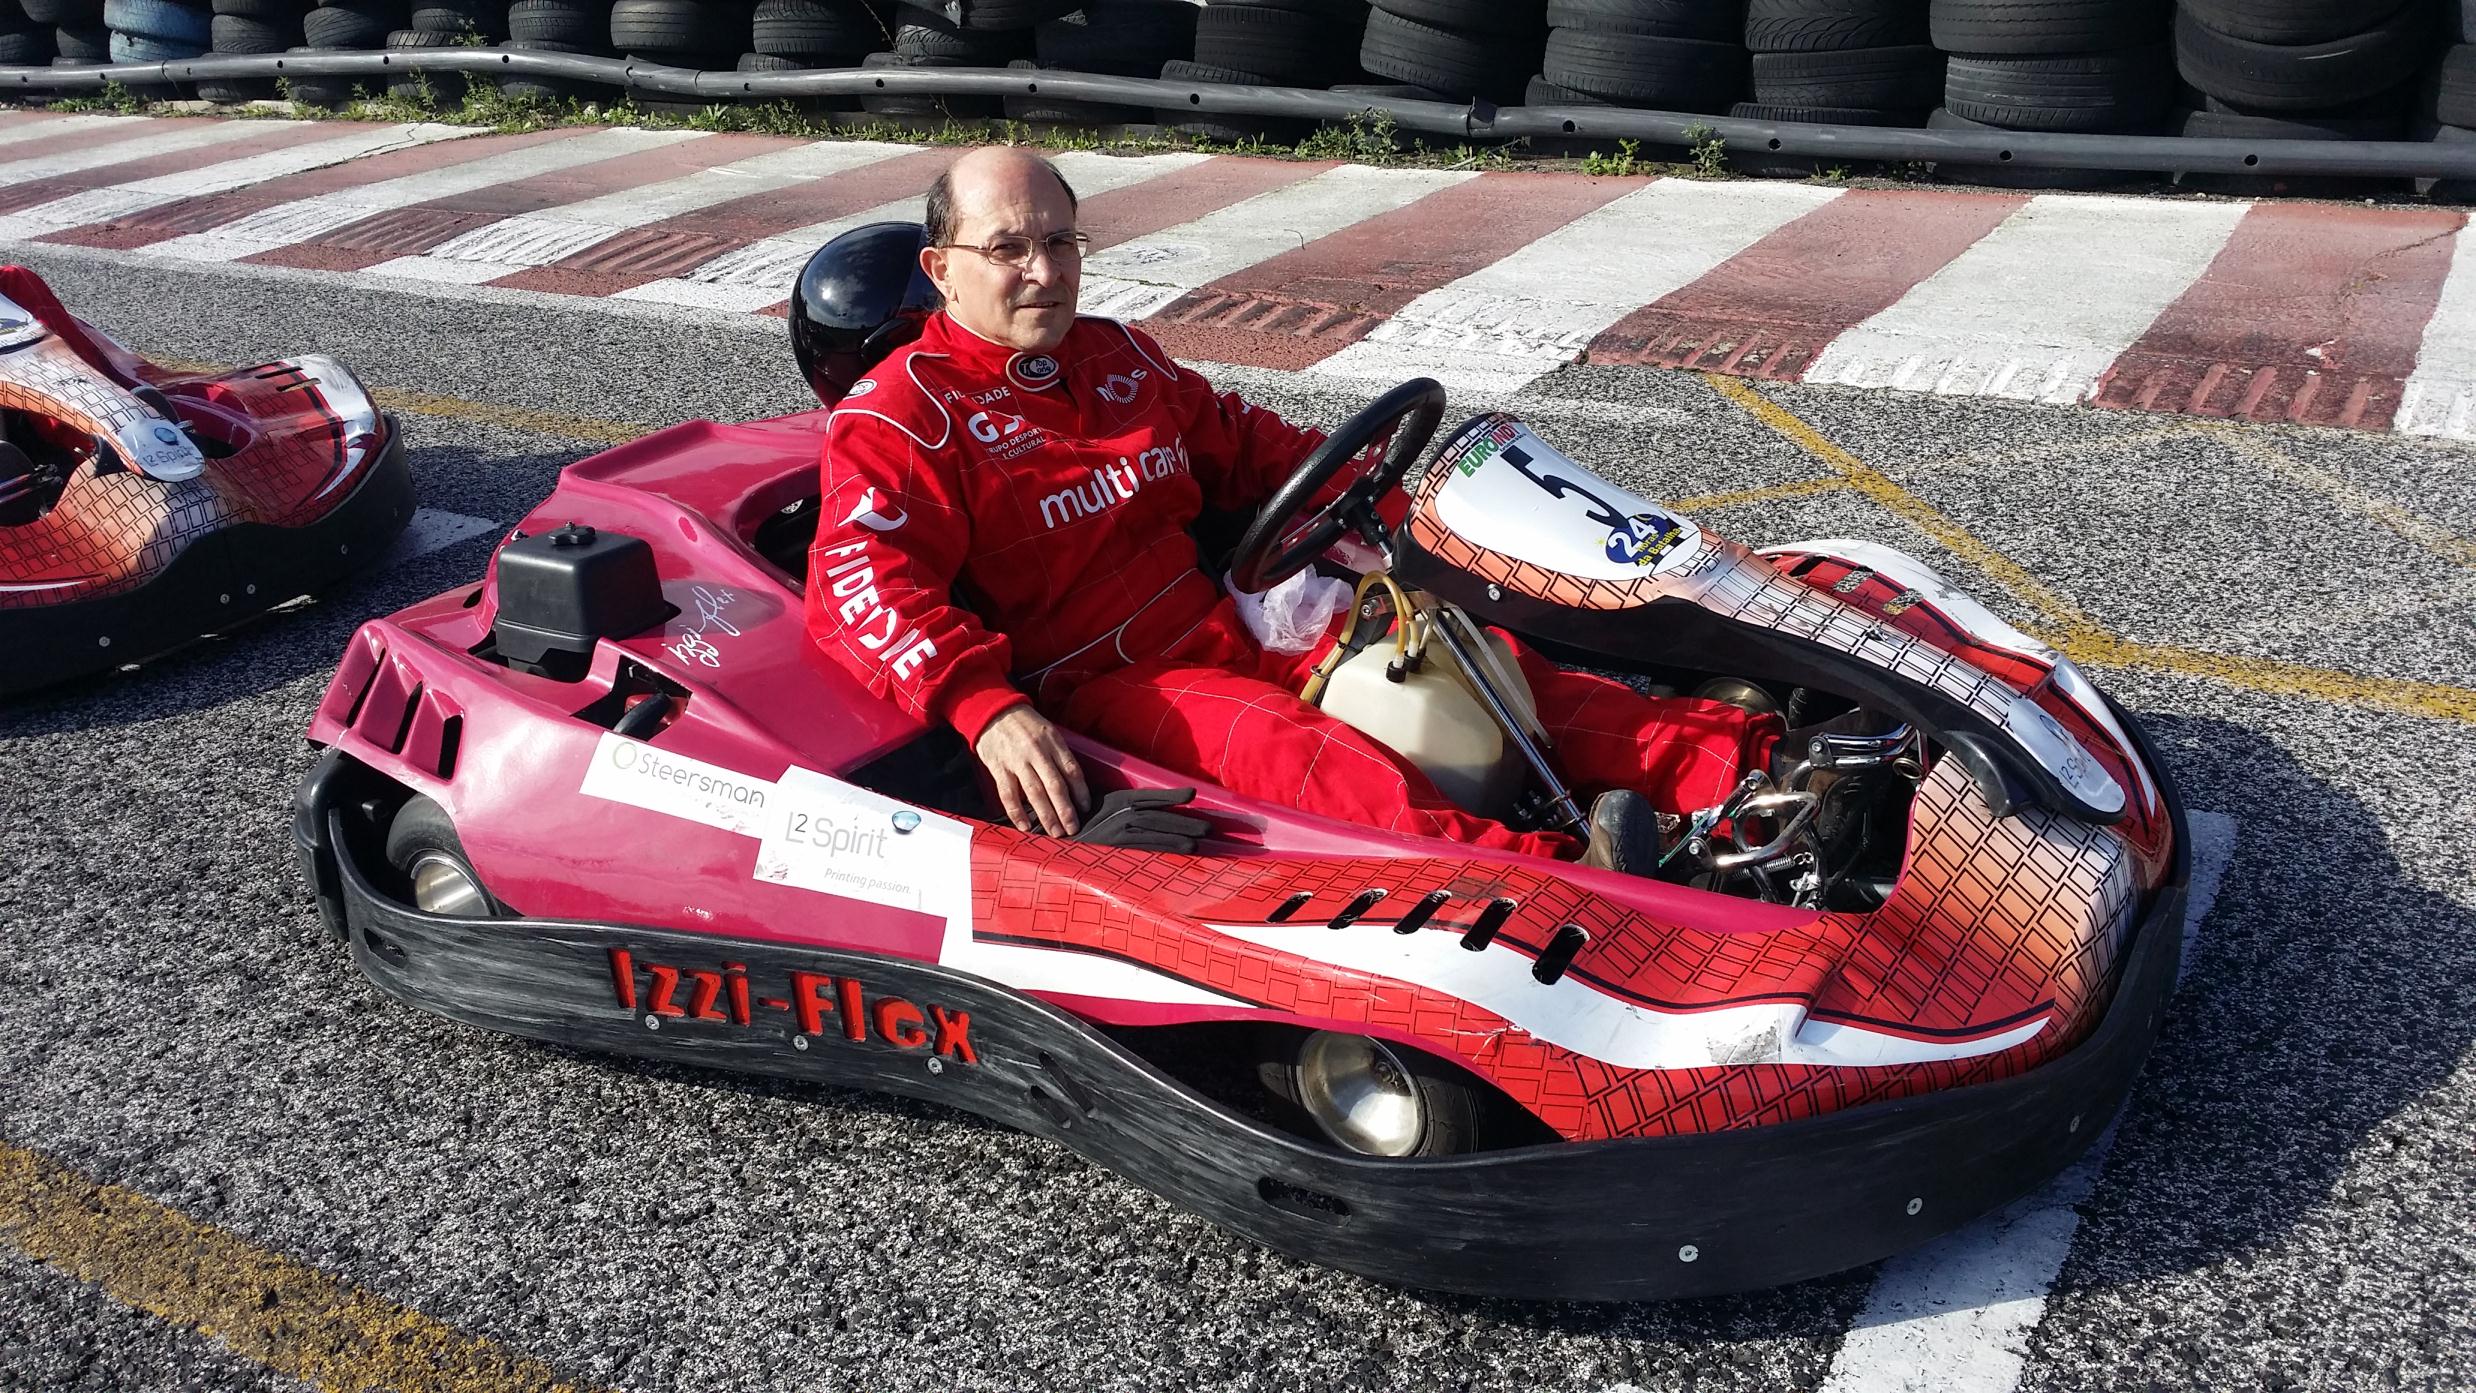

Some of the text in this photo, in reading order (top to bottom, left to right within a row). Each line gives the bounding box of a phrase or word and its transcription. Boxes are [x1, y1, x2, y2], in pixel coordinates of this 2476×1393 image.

[987, 442, 1009, 453] RUPO
[1008, 436, 1047, 457] CULTURAL
[1500, 445, 1631, 528] 5
[1606, 517, 1659, 558] 24
[1639, 527, 1681, 566] da Batalha
[638, 752, 765, 808] Steersman
[812, 817, 888, 858] Spirit
[824, 867, 912, 895] Printing passion.
